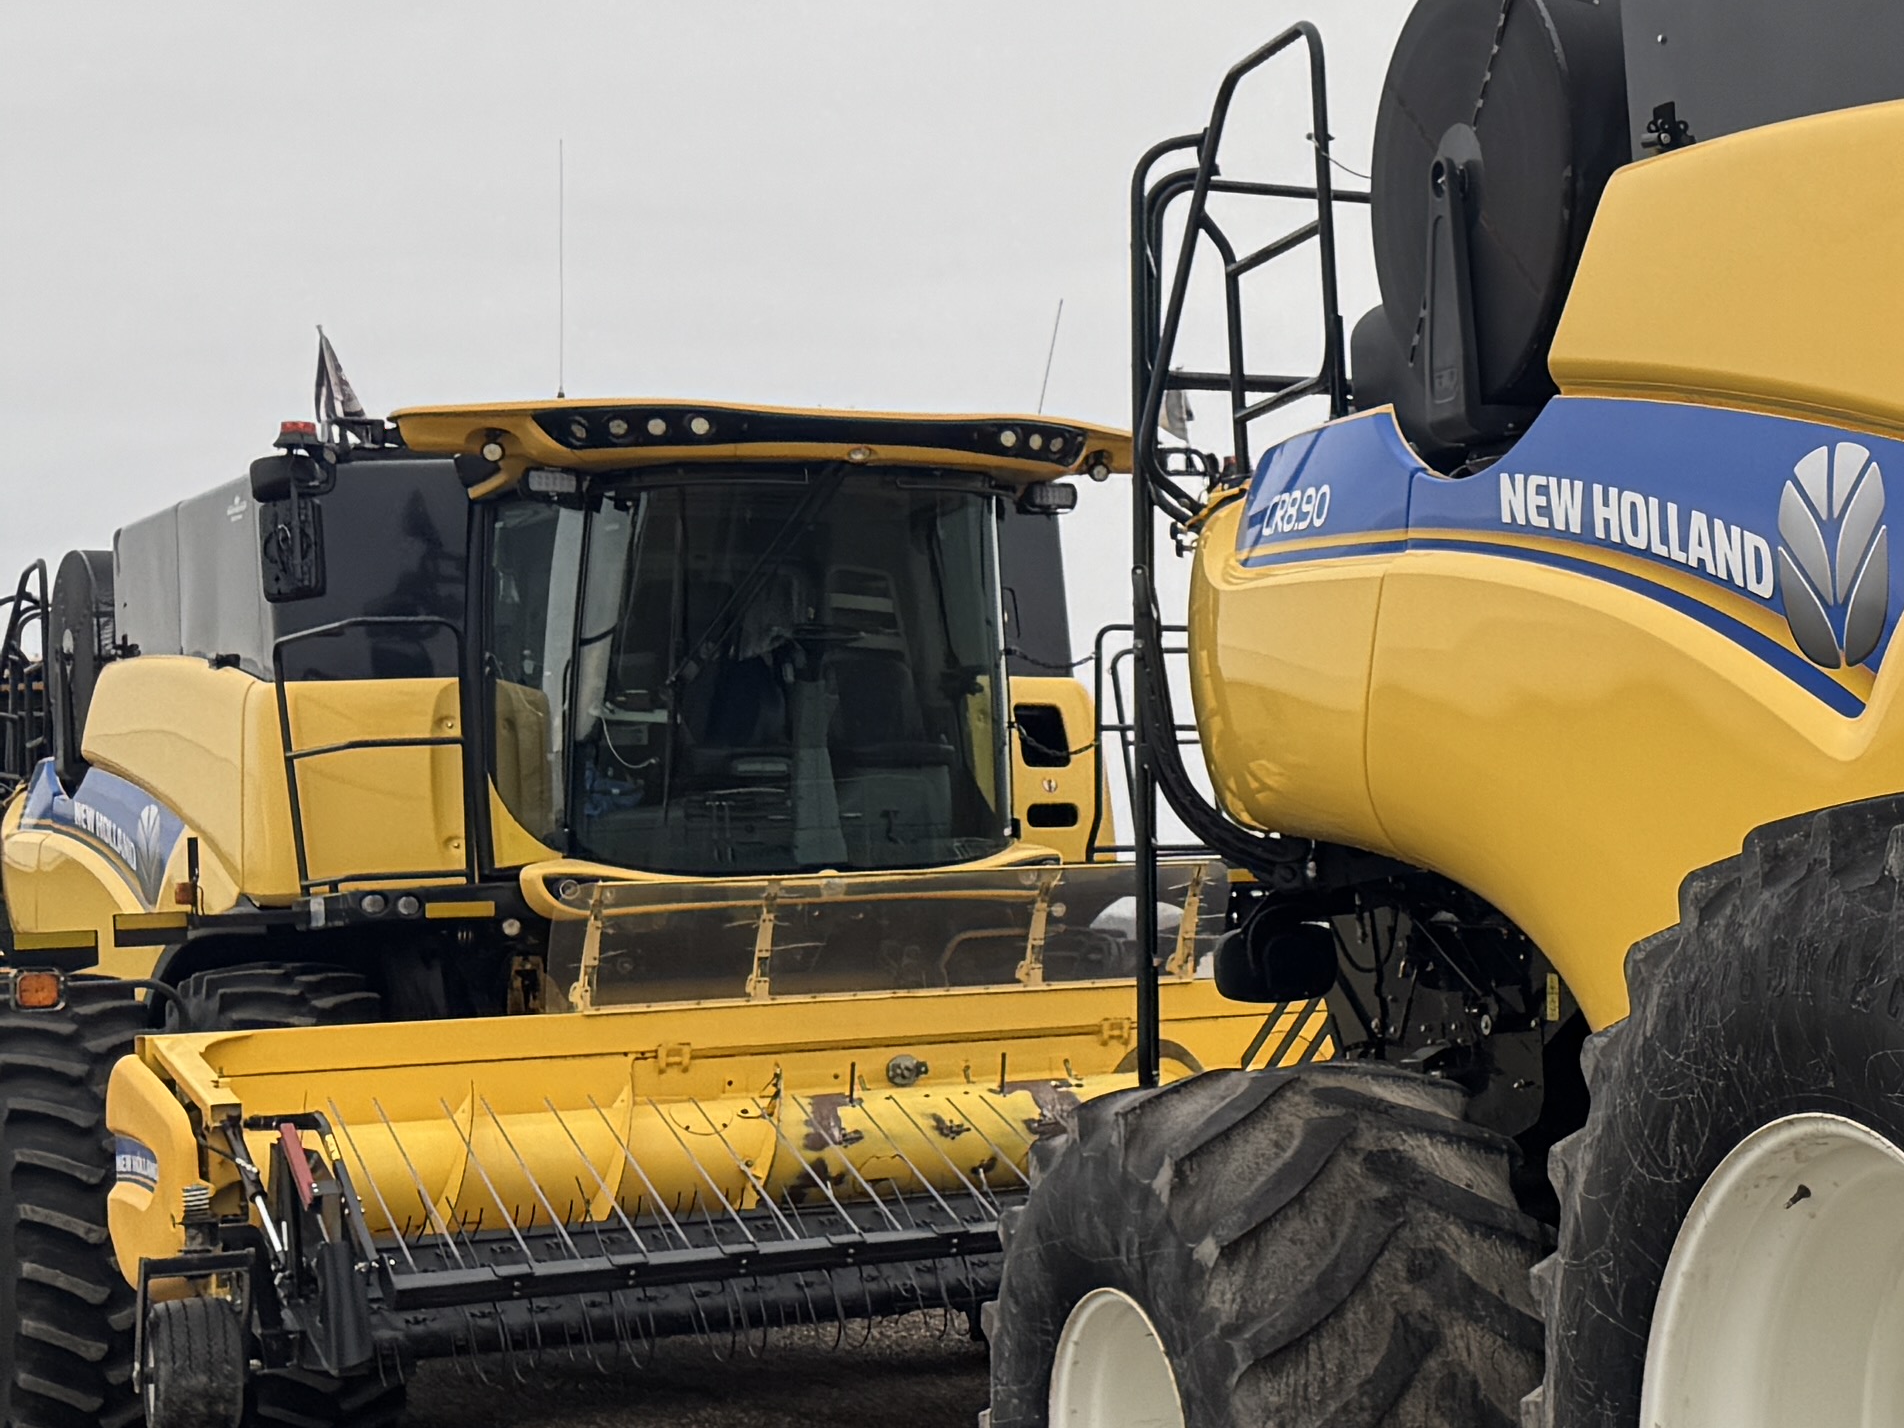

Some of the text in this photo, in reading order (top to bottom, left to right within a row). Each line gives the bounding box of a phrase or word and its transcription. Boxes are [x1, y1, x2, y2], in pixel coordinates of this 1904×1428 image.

[1262, 484, 1330, 536] CR8.90
[1499, 472, 1775, 600] NEW HOLLAND
